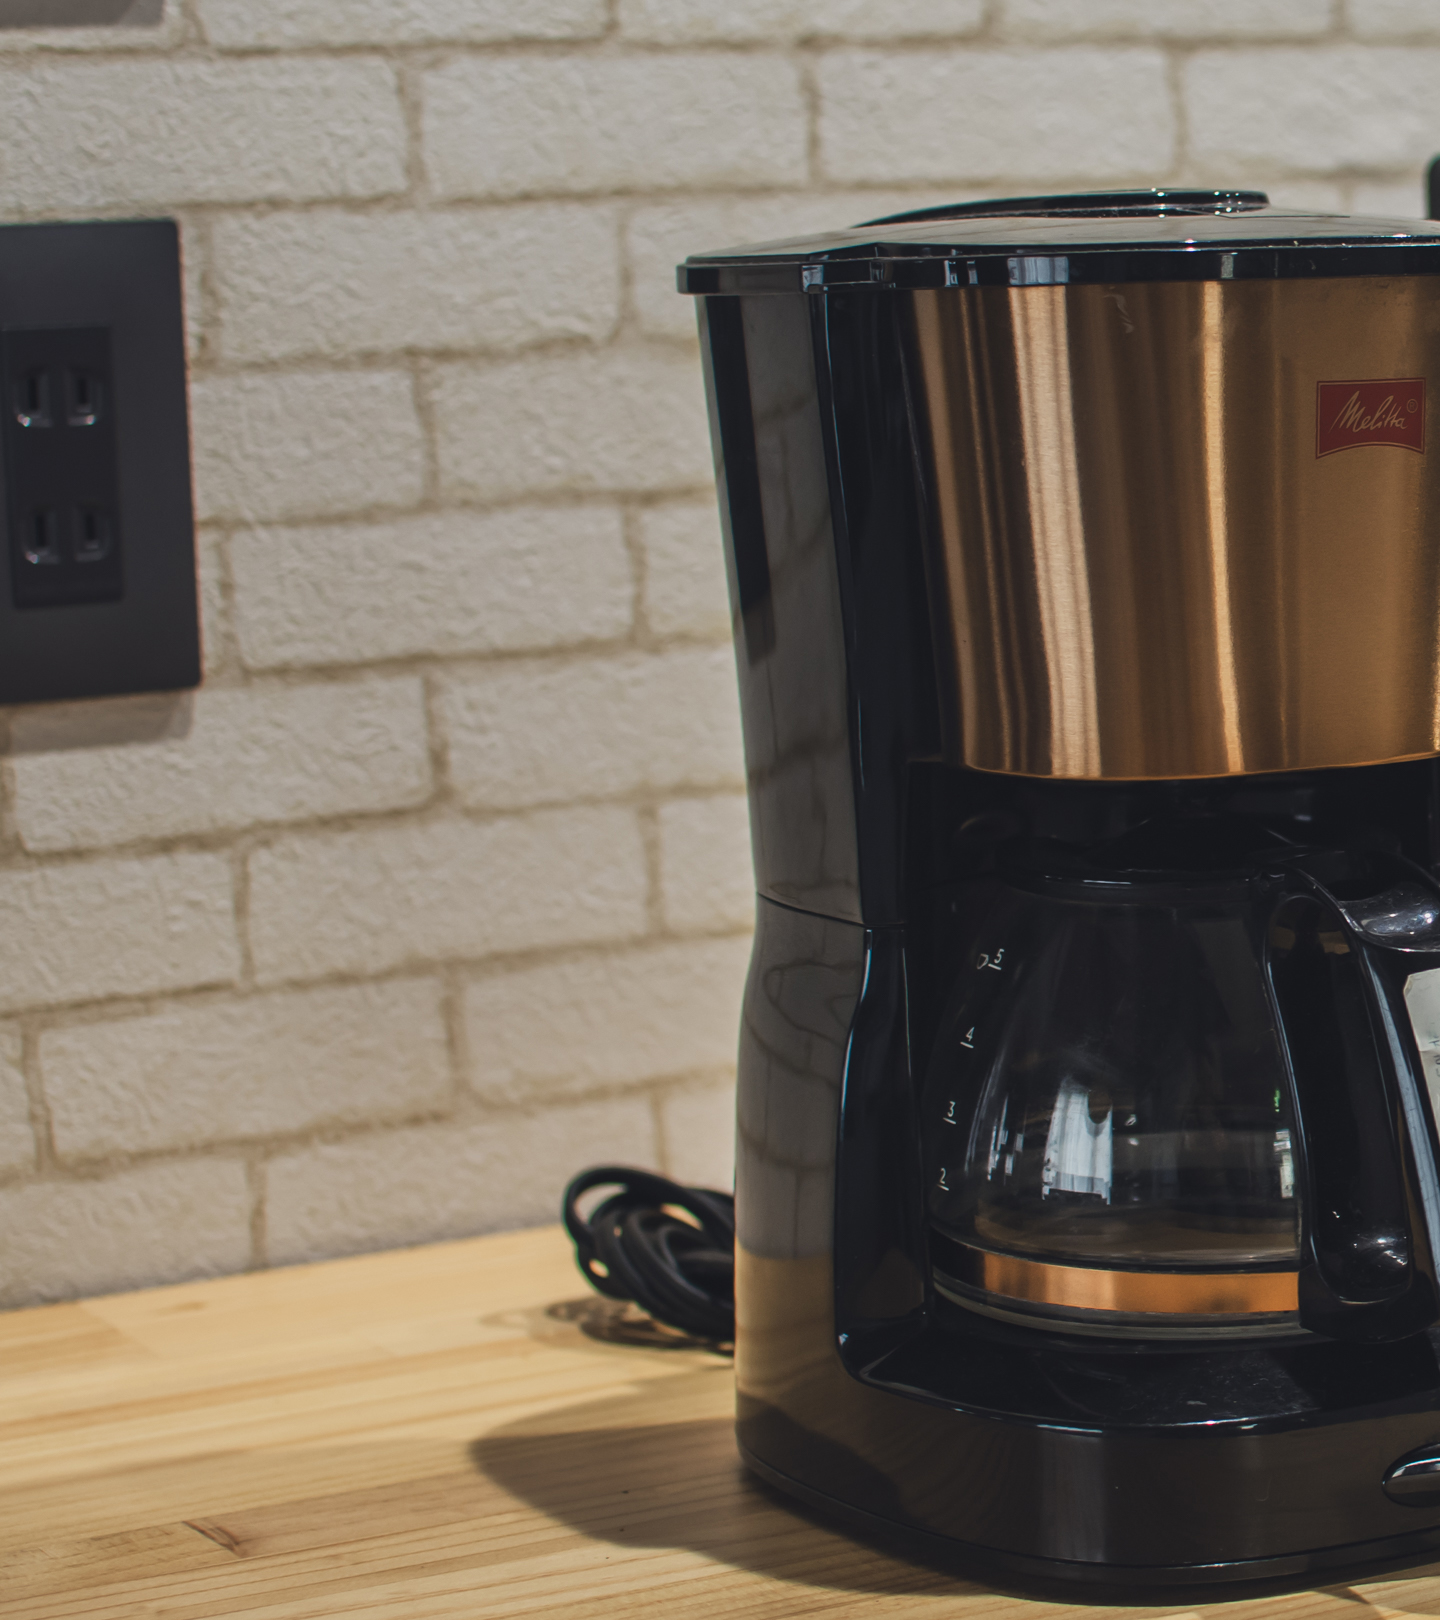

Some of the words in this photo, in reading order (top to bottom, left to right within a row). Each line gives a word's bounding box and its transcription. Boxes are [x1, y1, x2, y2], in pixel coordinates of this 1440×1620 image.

[993, 948, 1005, 964] 5
[965, 1026, 975, 1042] 4
[947, 1101, 956, 1118] 3
[939, 1167, 947, 1184] 2
